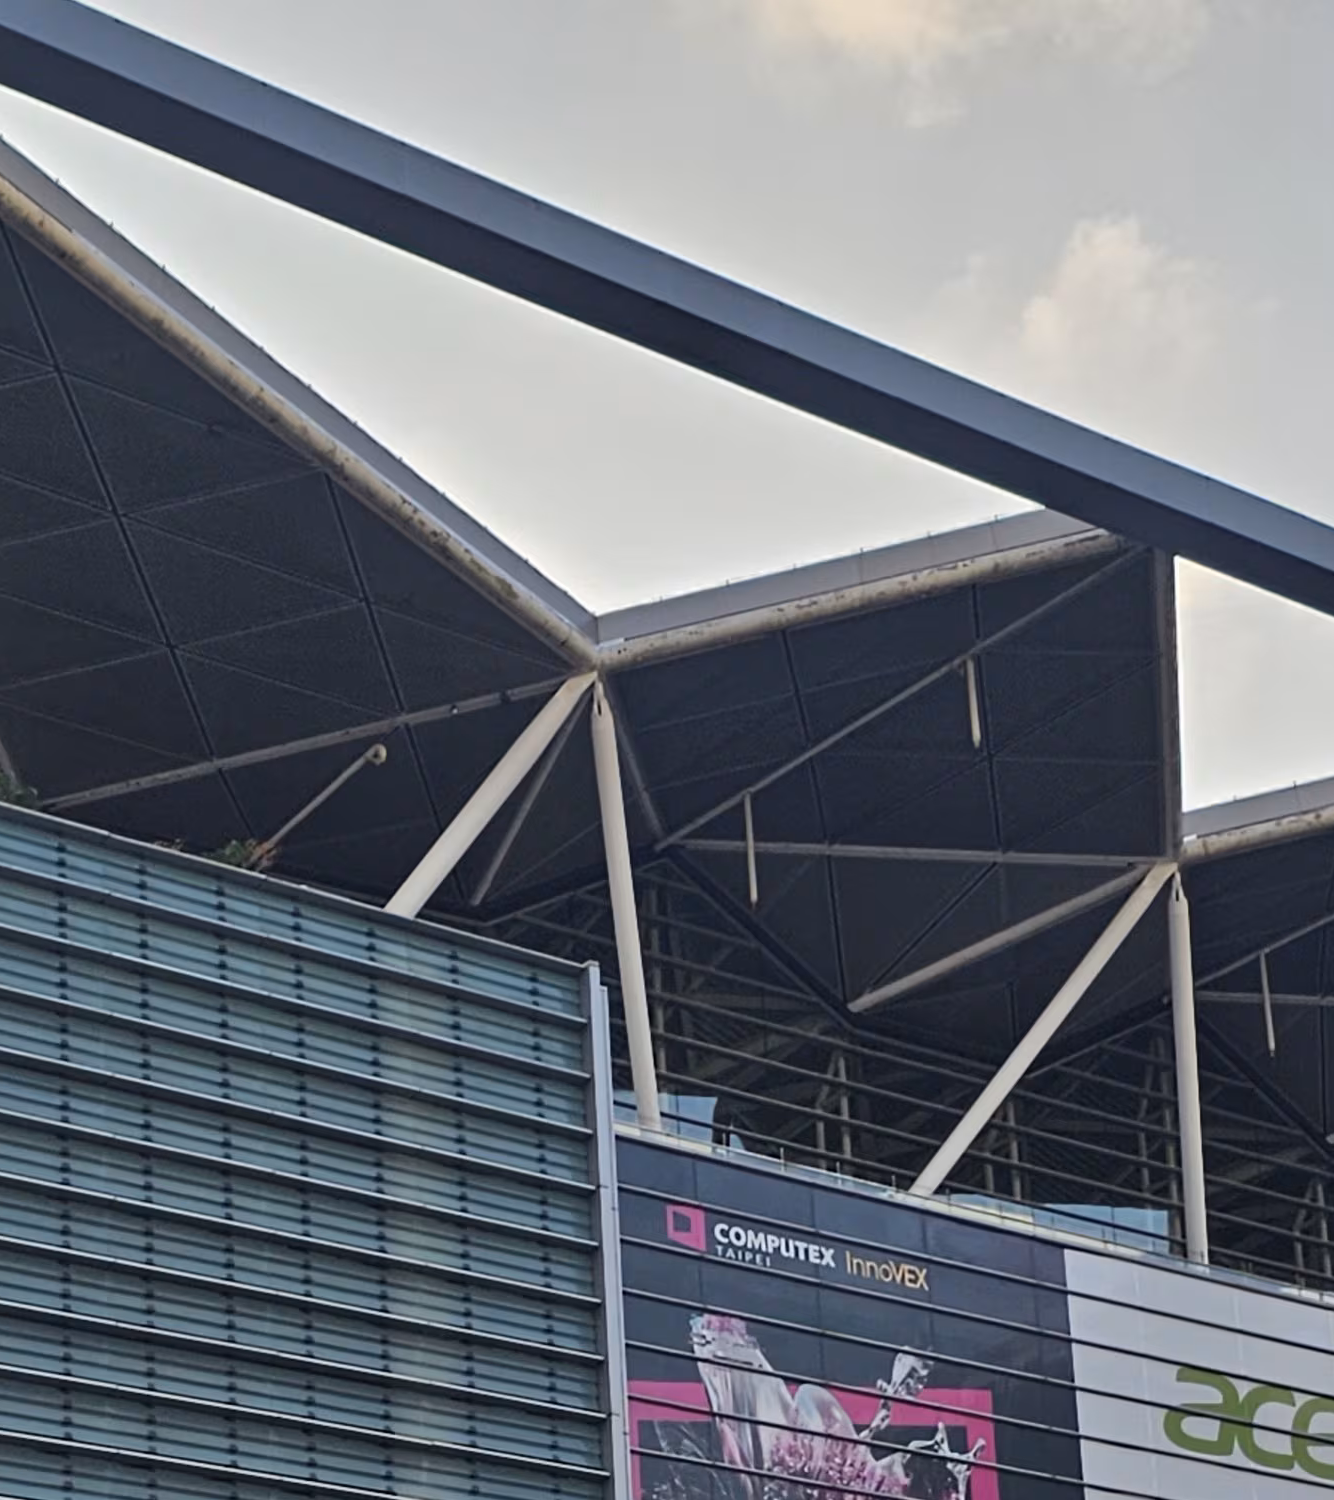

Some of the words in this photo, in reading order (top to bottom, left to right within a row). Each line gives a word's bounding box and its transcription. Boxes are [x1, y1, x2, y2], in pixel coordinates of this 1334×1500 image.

[714, 1223, 835, 1268] COMPUTEX
[845, 1250, 929, 1291] InnoVEX
[716, 1246, 771, 1268] TAIPEI
